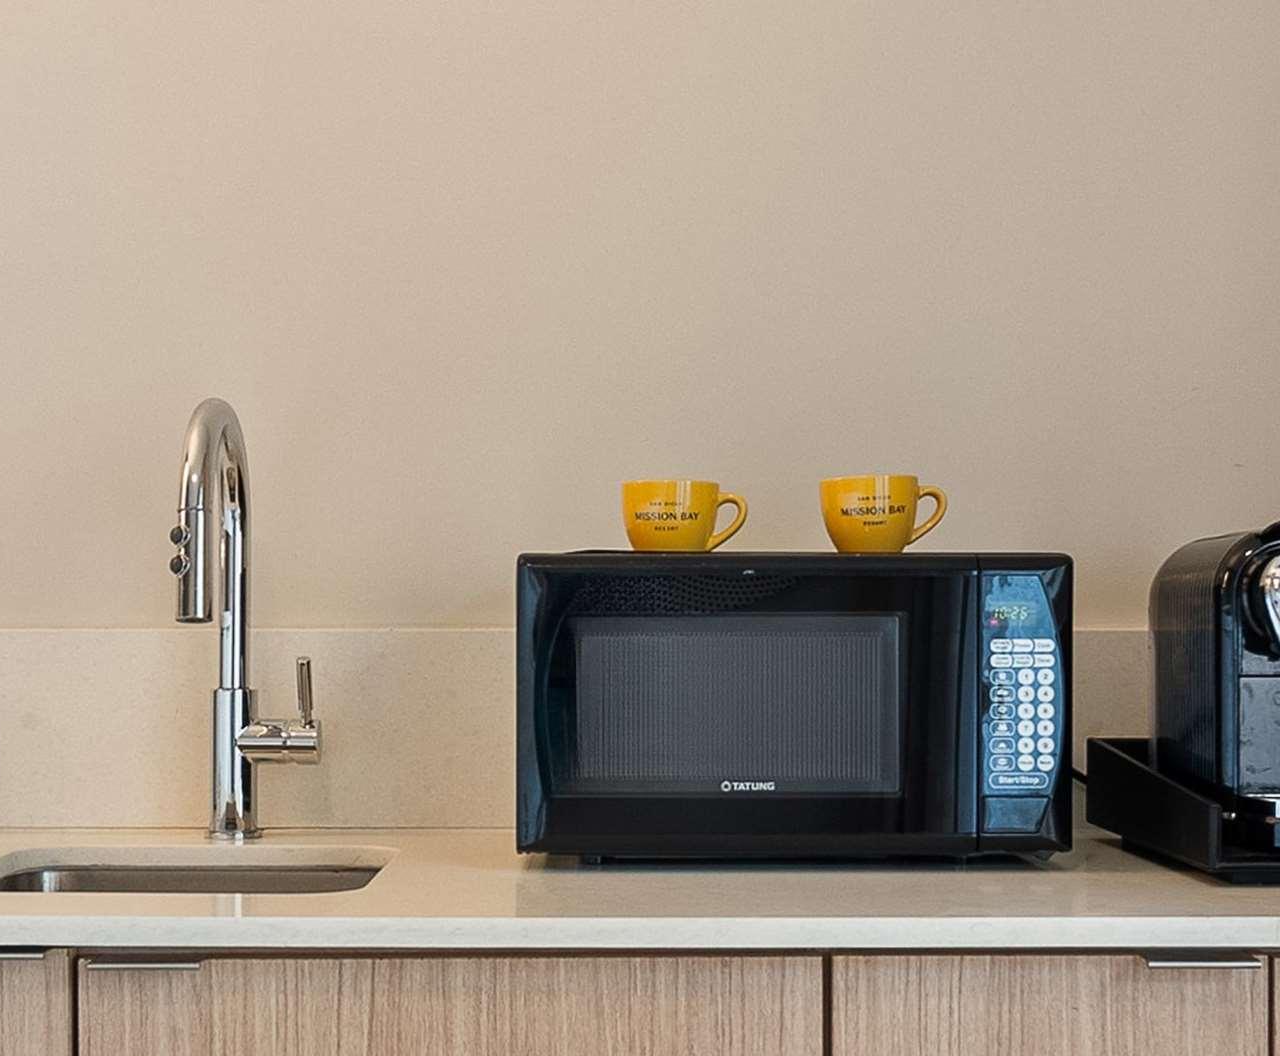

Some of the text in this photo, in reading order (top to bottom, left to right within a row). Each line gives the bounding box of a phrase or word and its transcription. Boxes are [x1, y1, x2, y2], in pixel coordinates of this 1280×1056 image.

[840, 505, 907, 516] MISSION BAY
[634, 512, 700, 521] MISSION BAY
[732, 781, 775, 791] TATUNG
